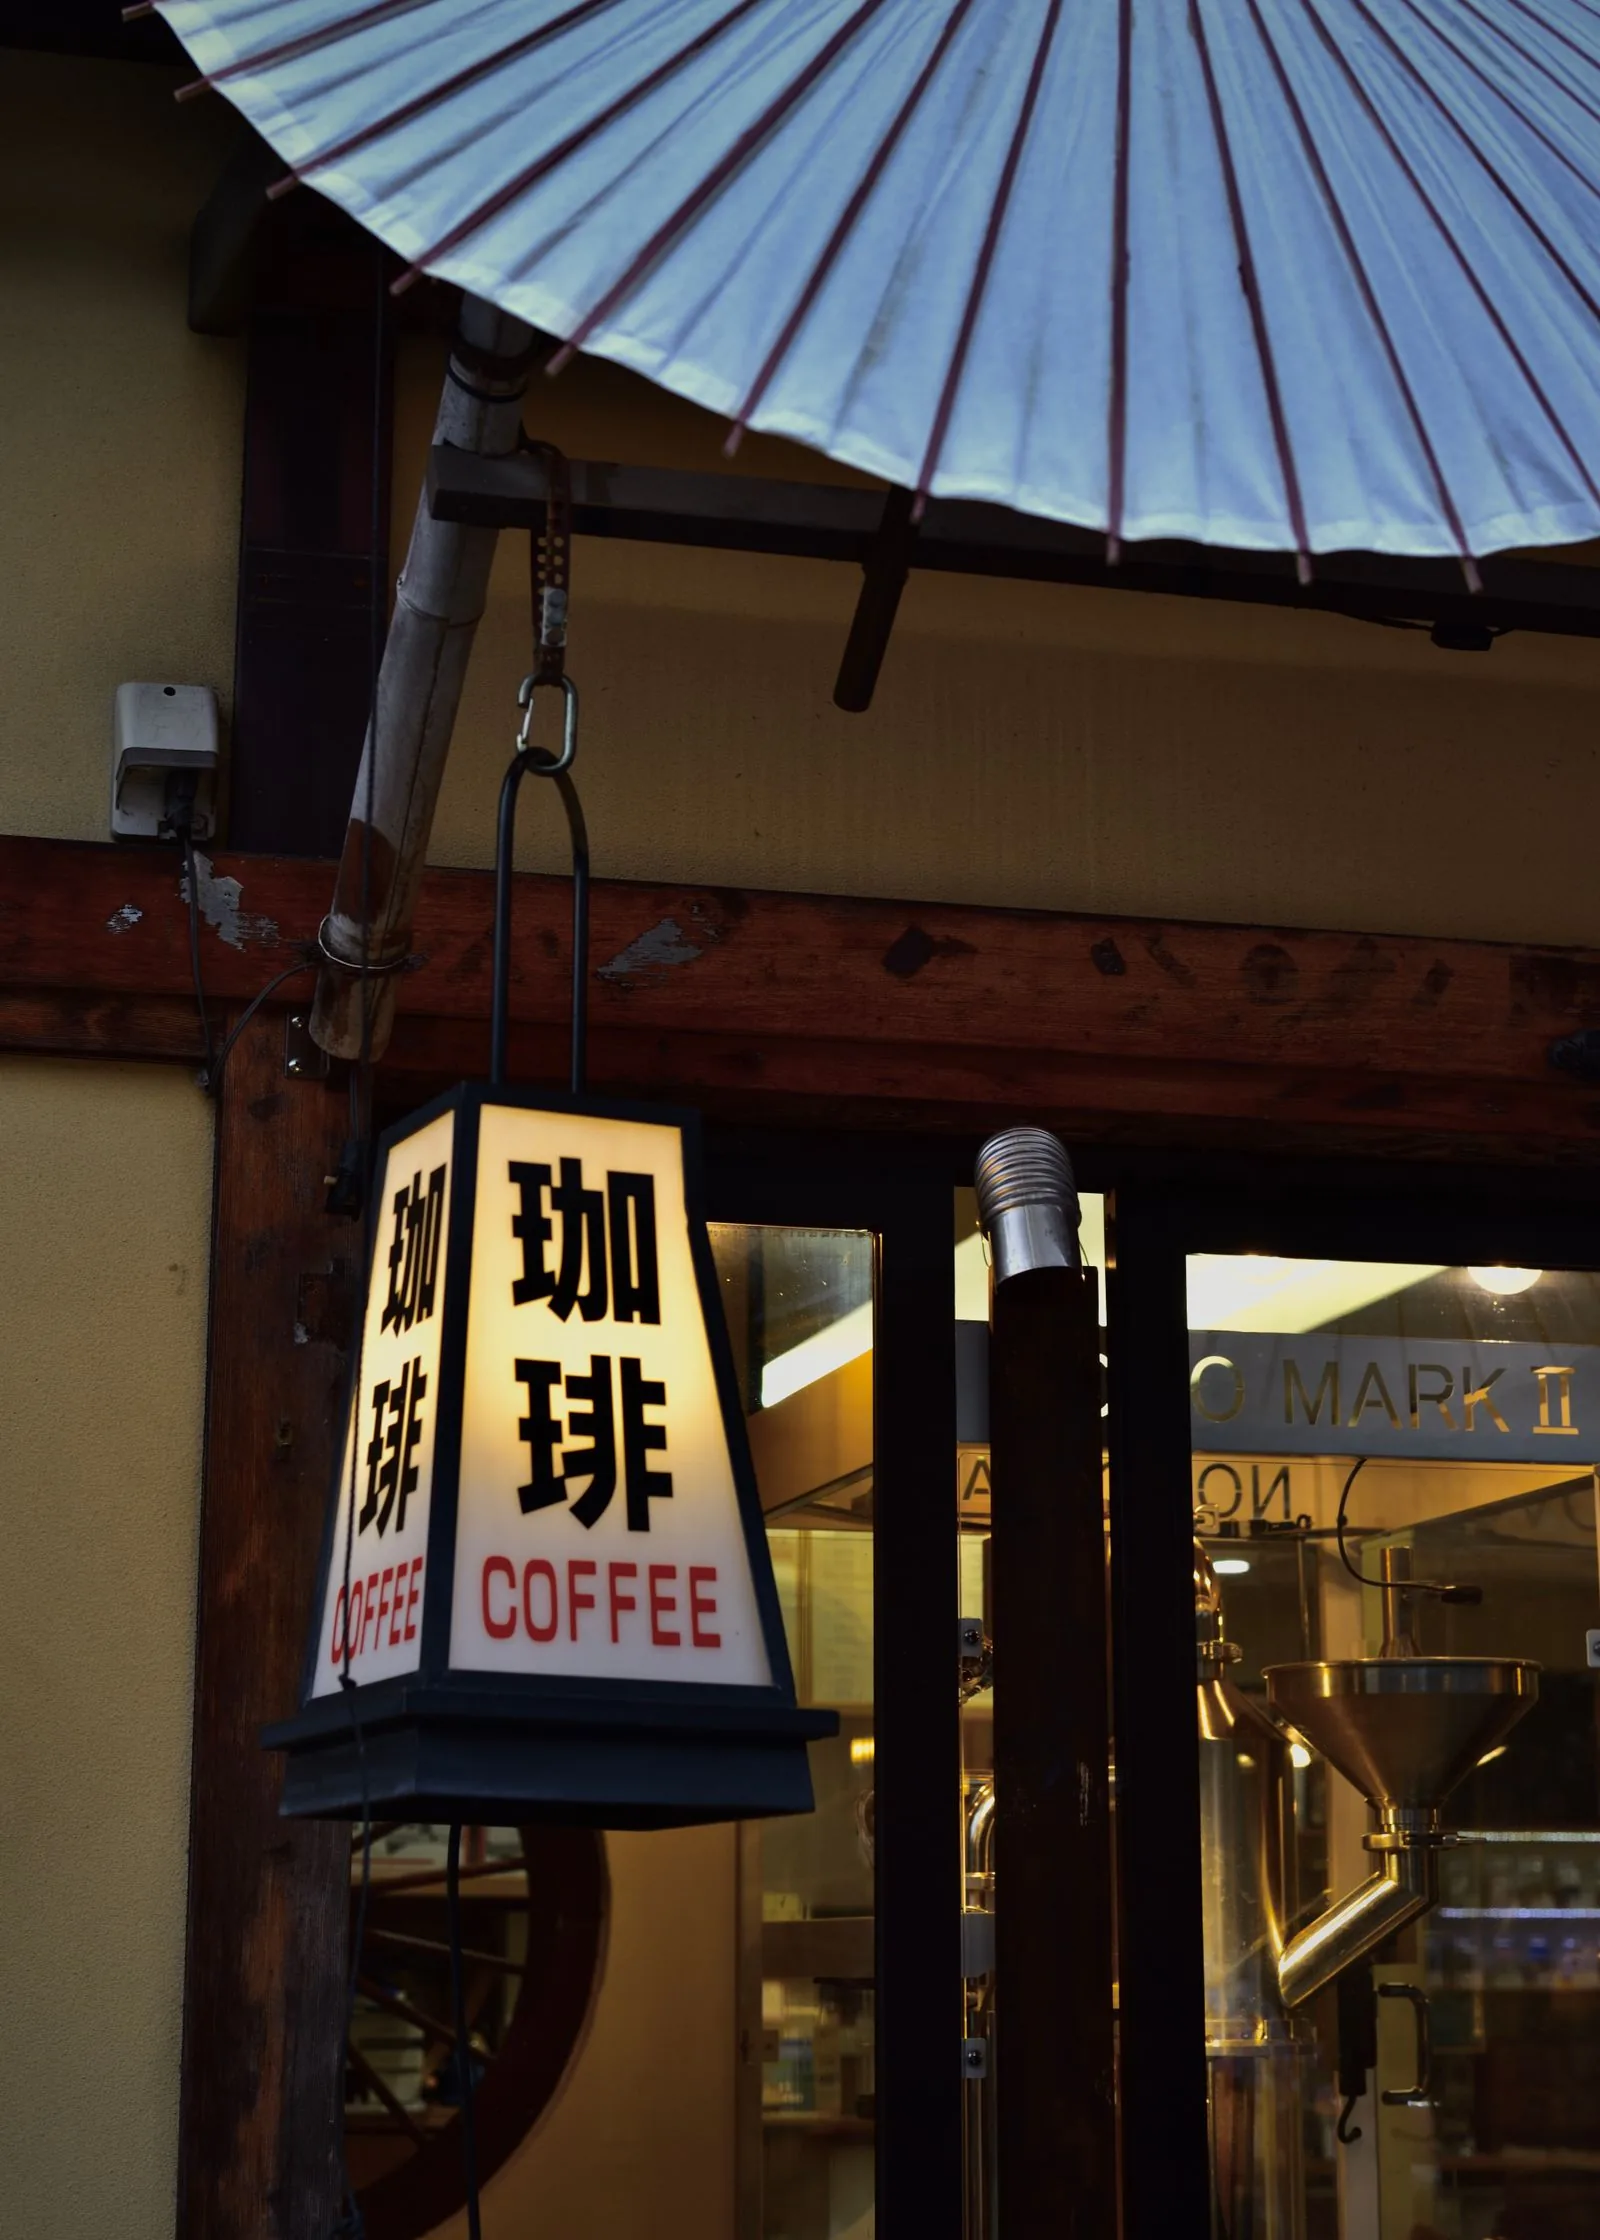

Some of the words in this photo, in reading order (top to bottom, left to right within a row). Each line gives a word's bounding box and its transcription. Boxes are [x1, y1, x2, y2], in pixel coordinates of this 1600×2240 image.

[358, 1161, 447, 1538] 珈琲
[507, 1157, 674, 1533] 珈琲
[1283, 1358, 1511, 1434] MARK
[331, 1556, 424, 1664] COFFEE
[481, 1555, 723, 1649] COFFEE
